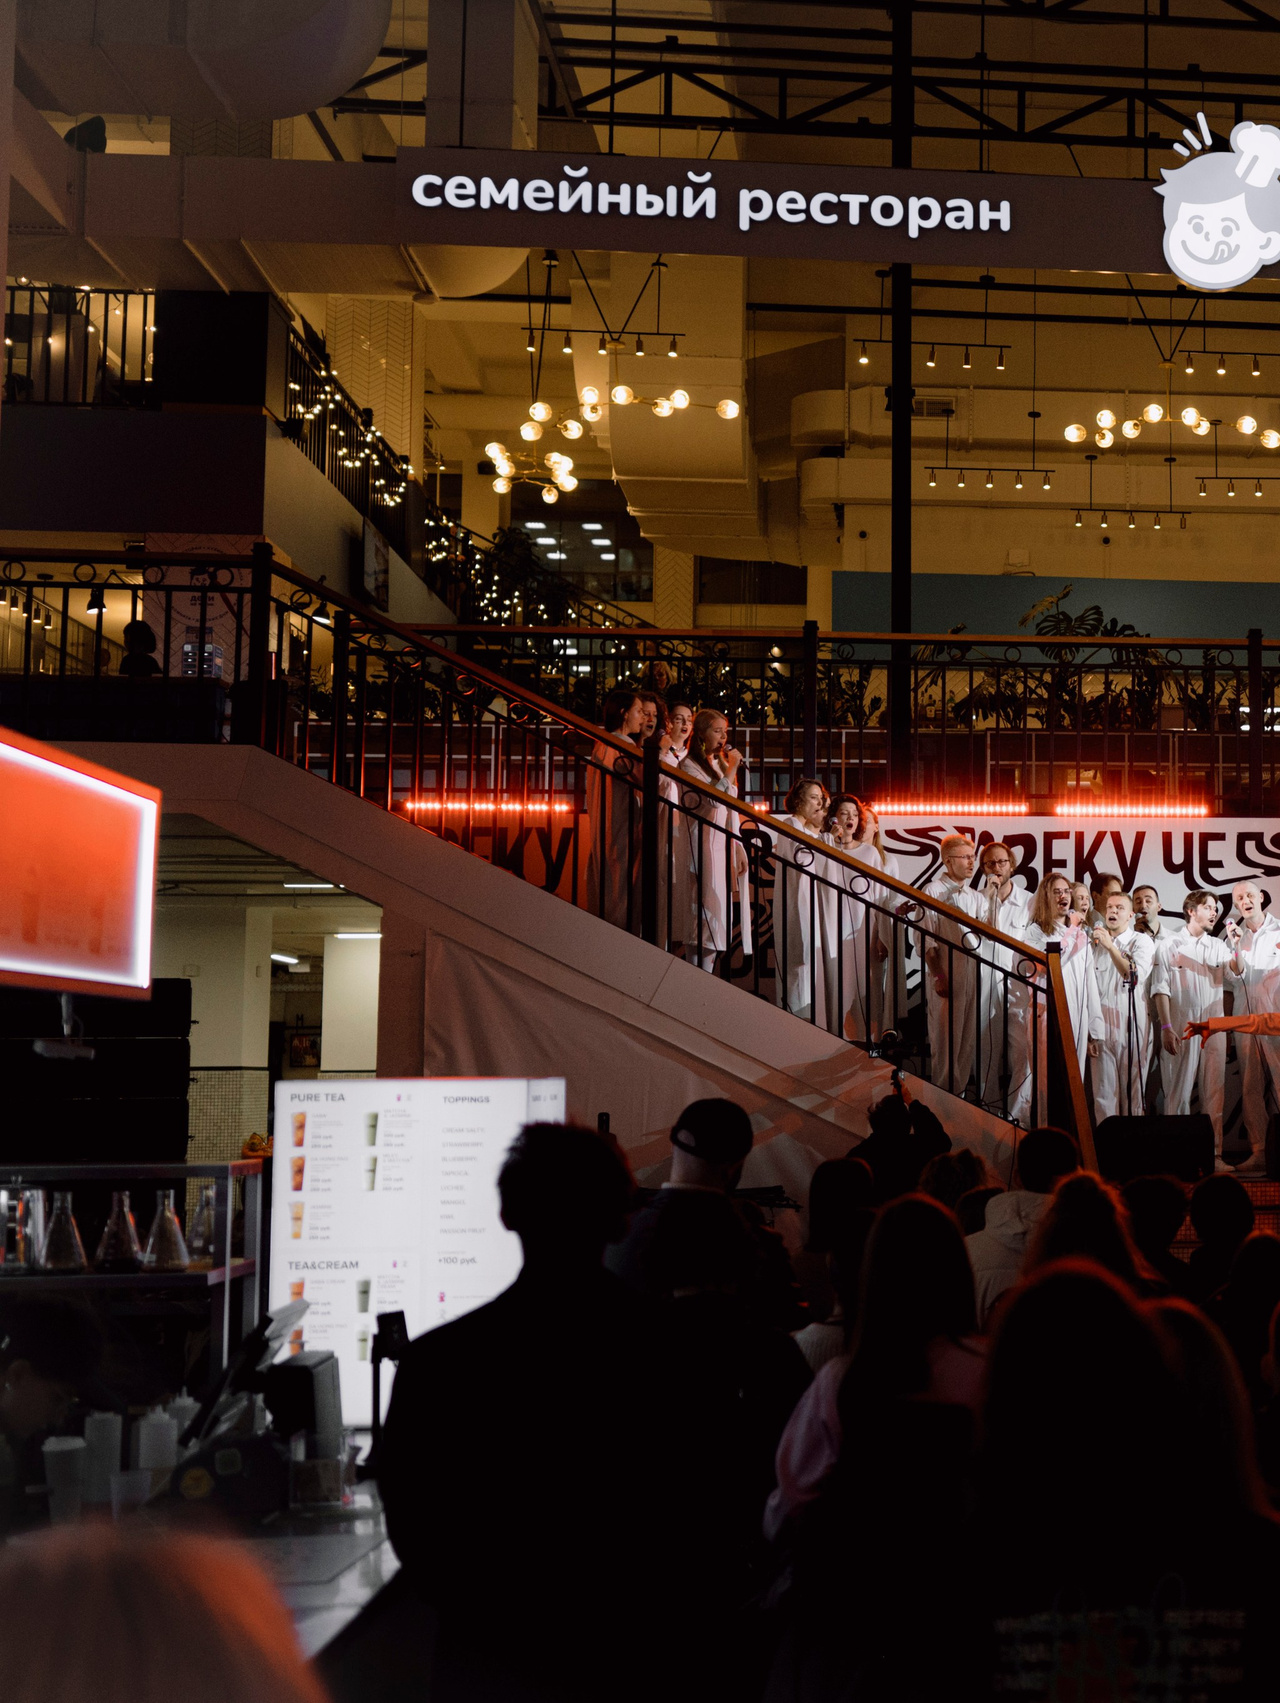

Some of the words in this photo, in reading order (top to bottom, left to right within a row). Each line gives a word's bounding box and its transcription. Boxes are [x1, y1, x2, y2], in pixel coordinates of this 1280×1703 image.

[413, 166, 717, 219] семейный
[740, 189, 1012, 240] ресторан
[290, 1093, 320, 1103] PURE
[324, 1093, 346, 1103] TEA
[443, 1096, 490, 1104] TOPPINGS
[288, 1260, 359, 1271] TEA&CREAM
